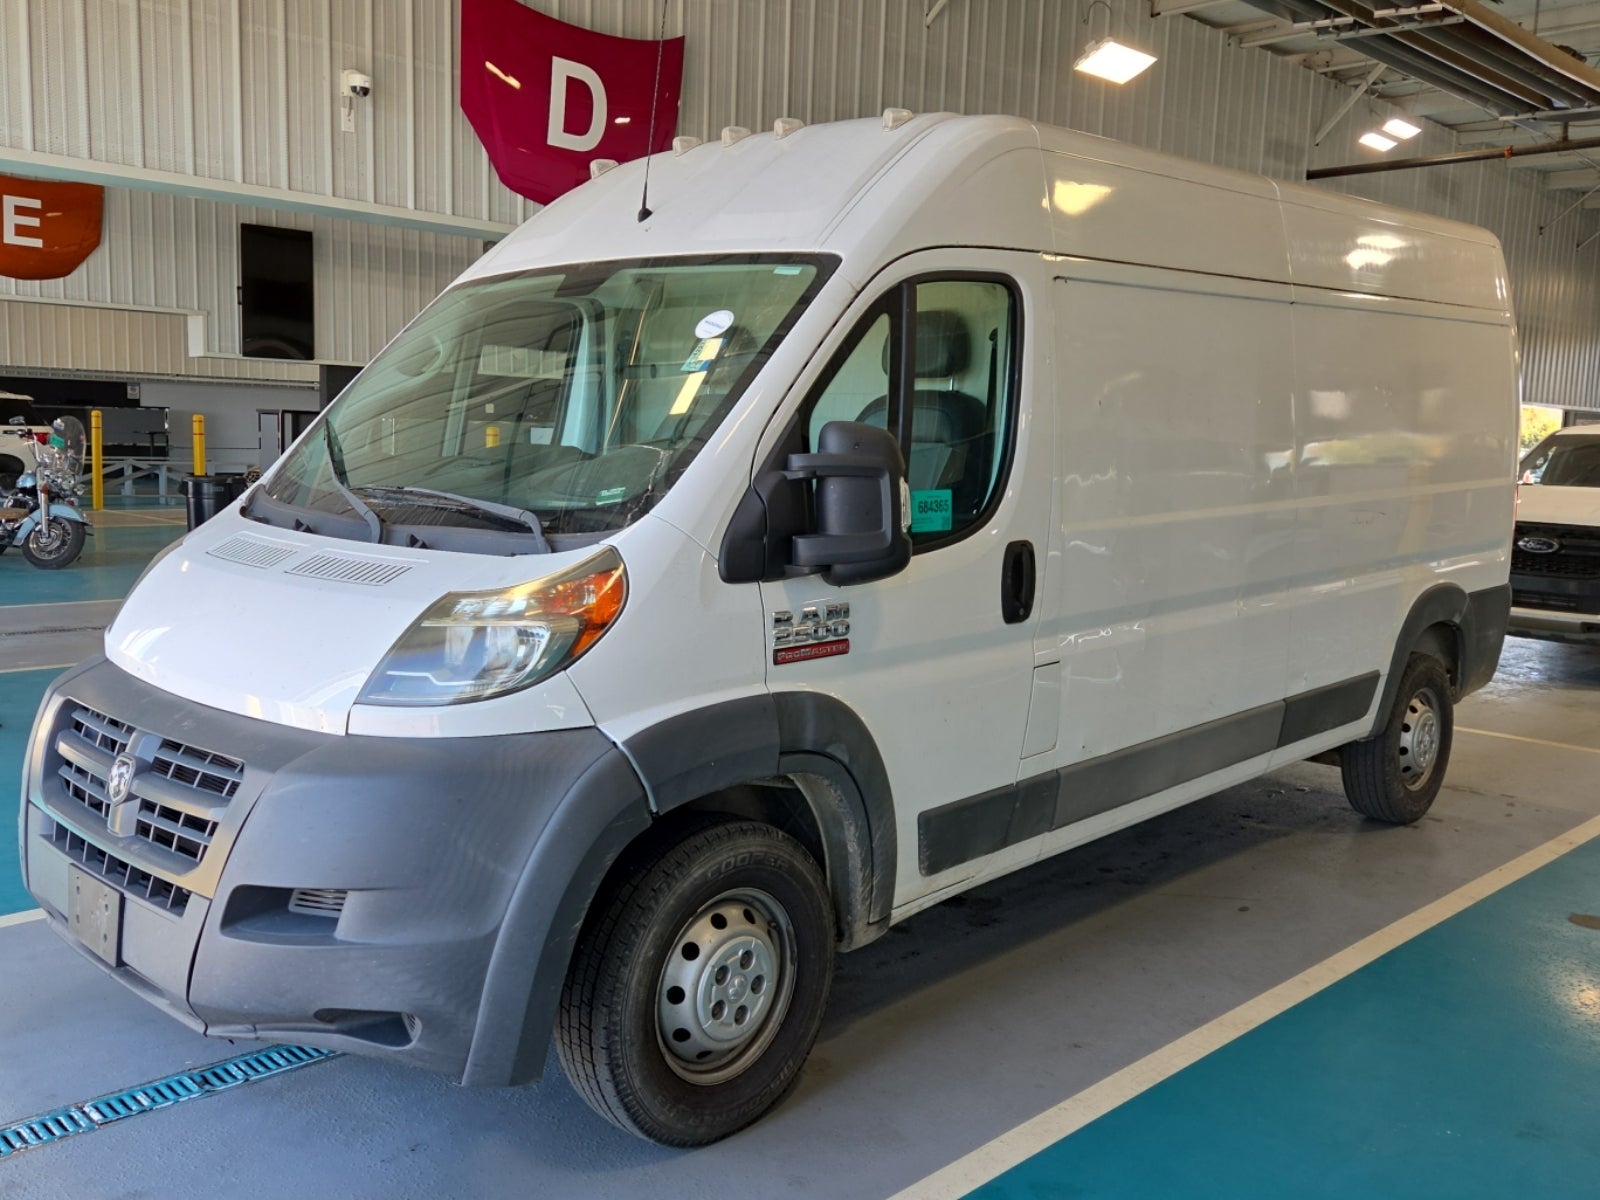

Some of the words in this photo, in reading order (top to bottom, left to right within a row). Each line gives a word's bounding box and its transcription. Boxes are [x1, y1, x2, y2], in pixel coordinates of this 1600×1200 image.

[547, 55, 608, 152] D
[3, 195, 43, 248] E
[918, 499, 949, 514] 684365
[773, 620, 850, 646] 2500
